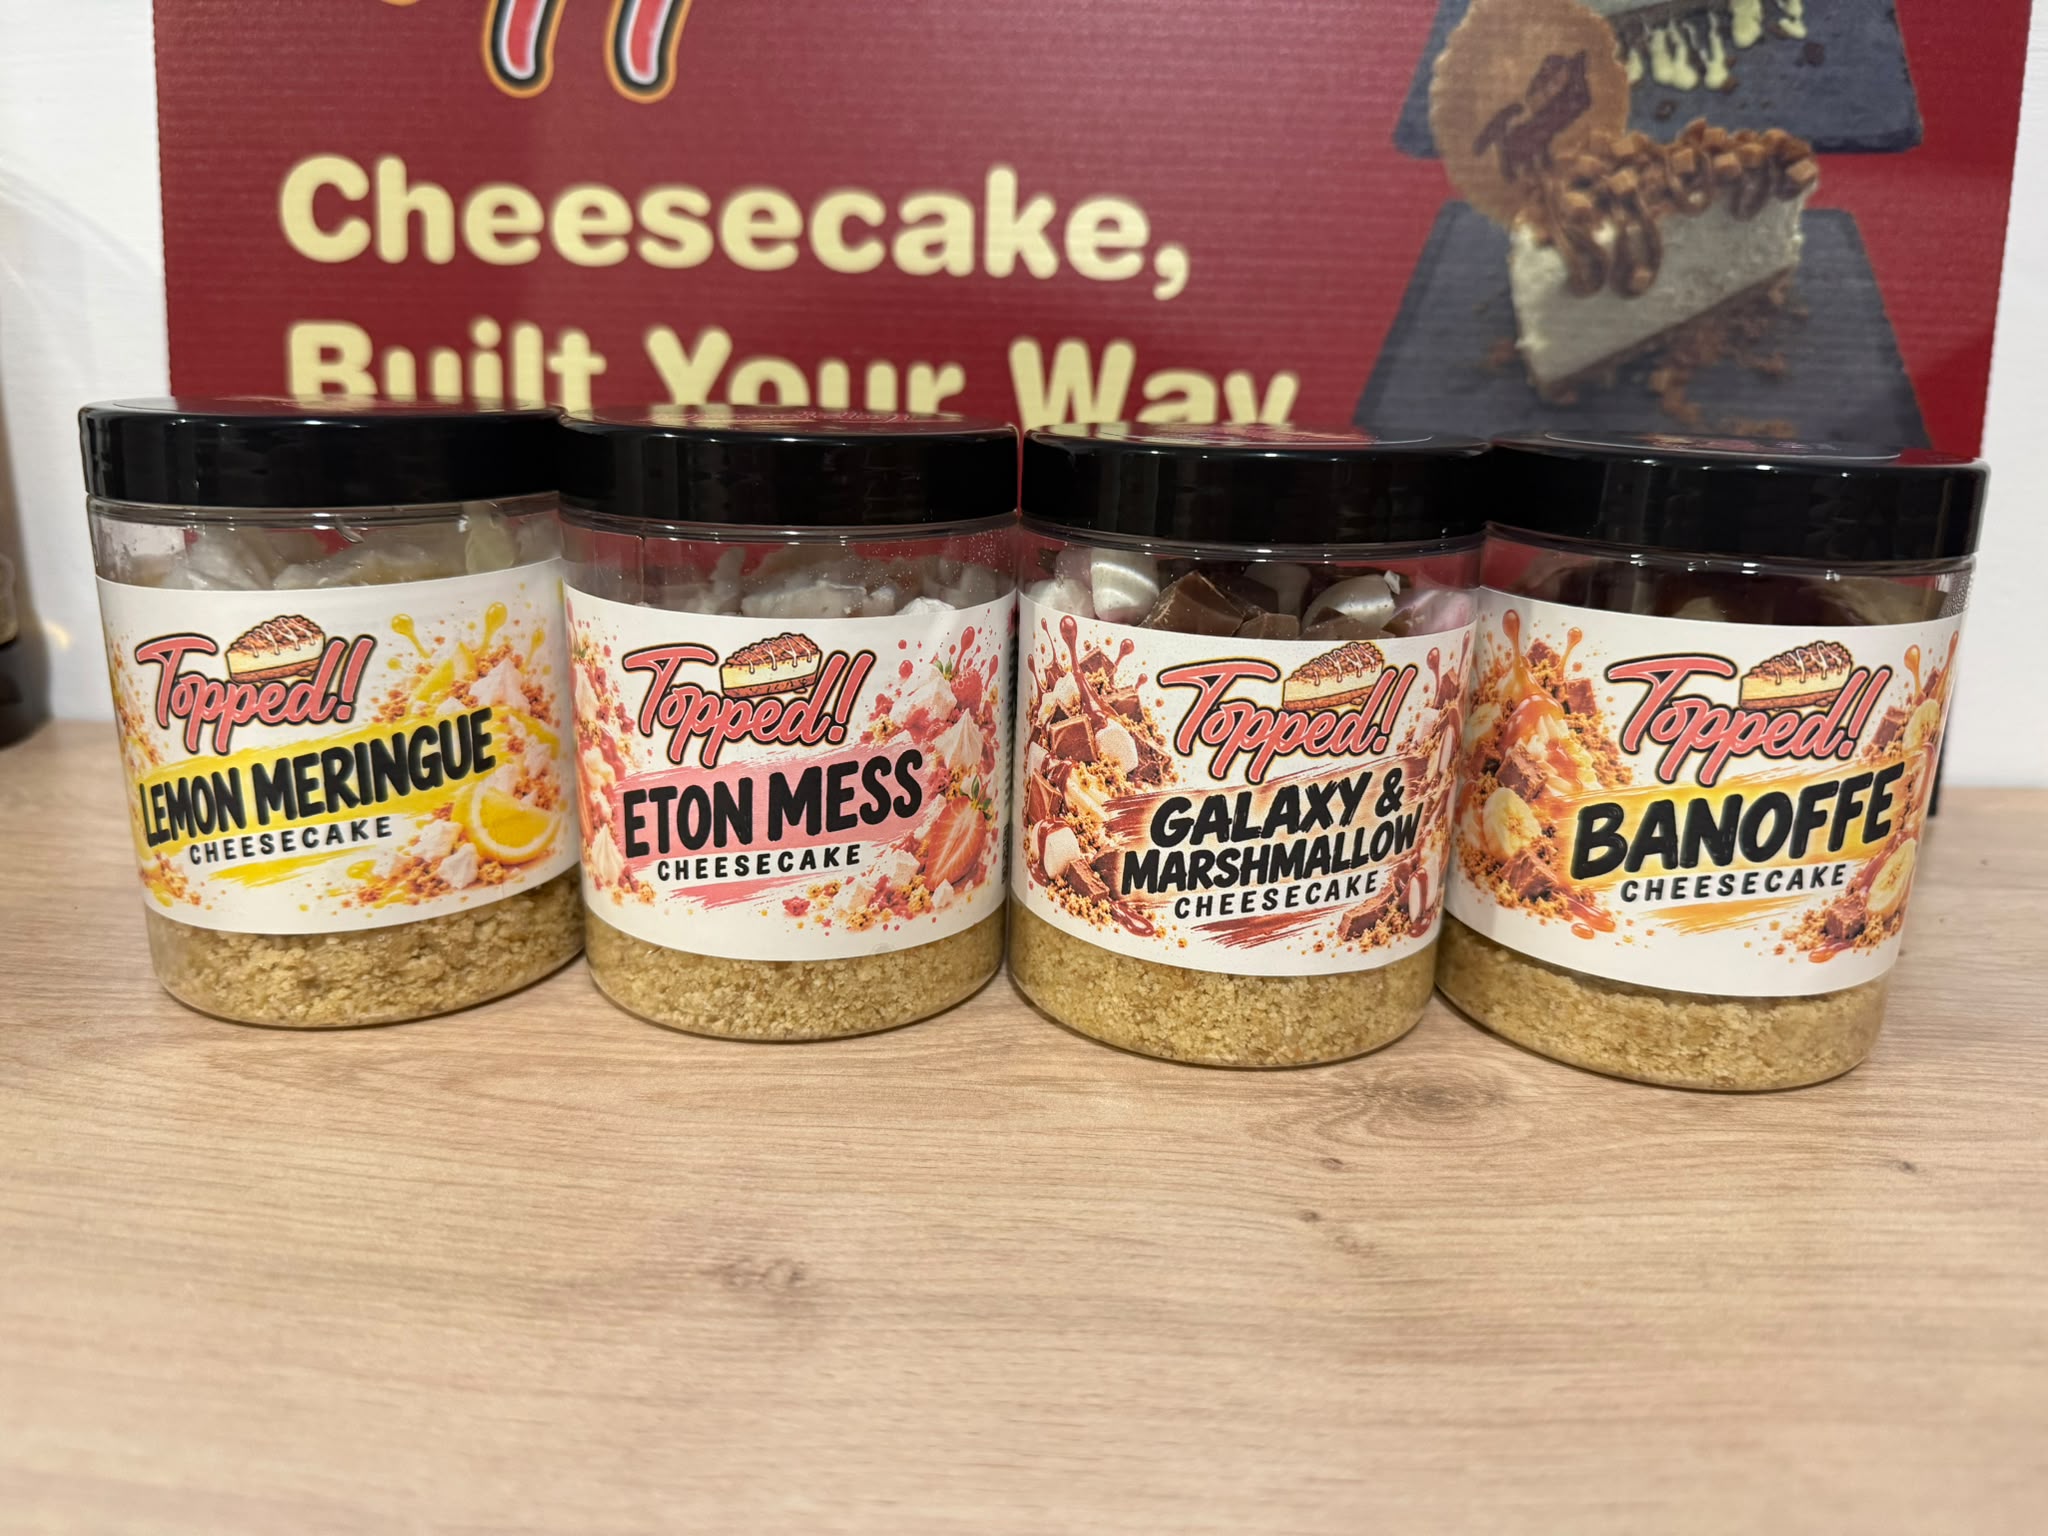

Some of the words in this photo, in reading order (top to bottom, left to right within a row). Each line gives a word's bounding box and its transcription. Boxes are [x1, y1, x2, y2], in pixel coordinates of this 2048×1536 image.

[281, 155, 1190, 300] Cheesecake,
[287, 317, 607, 411] Built
[645, 326, 966, 413] Your
[135, 632, 378, 755] Topped!
[622, 641, 876, 768] Topped!
[1157, 656, 1417, 785] Topped!
[1605, 653, 1891, 786] Topped!
[139, 766, 244, 848] LEMON
[252, 707, 496, 827] MERINGUE
[623, 776, 753, 858] ETON
[767, 749, 923, 842] MESS
[1150, 771, 1373, 848] GALAXY
[1374, 767, 1404, 817] &
[1570, 762, 1905, 880] BANOFFE
[188, 815, 393, 866] CHEESECAKE
[657, 843, 861, 882] CHEESECAKE
[1121, 802, 1423, 896] MARSHMALLOW
[1174, 870, 1378, 920] CHEESECAKE
[1621, 864, 1847, 903] CHEESECAKE
